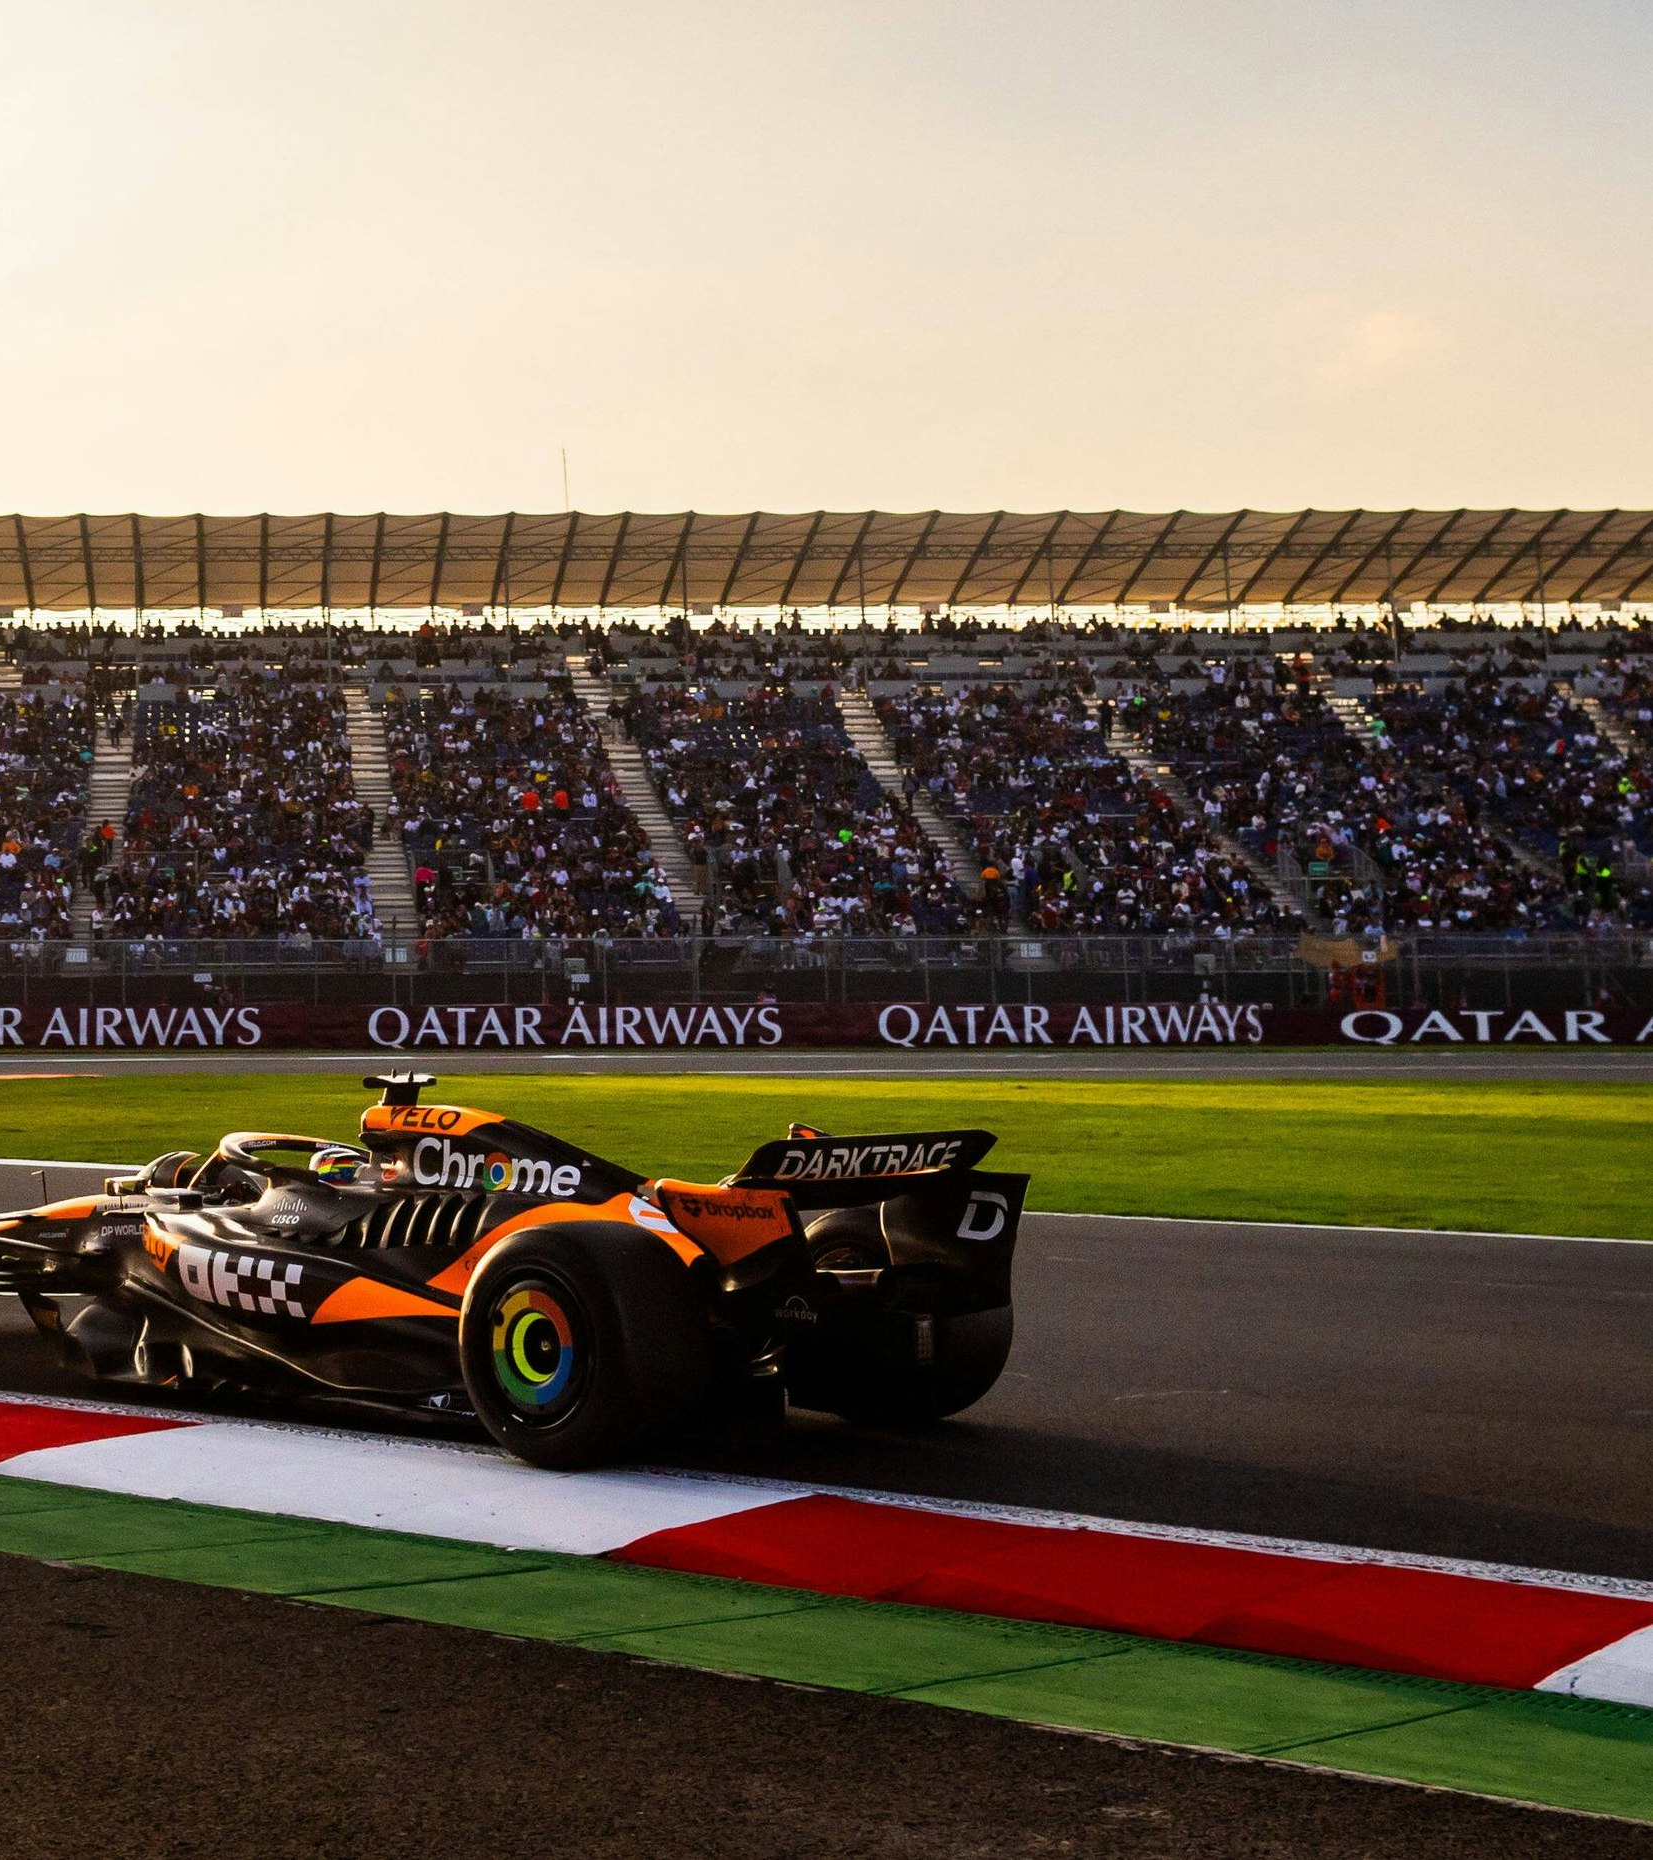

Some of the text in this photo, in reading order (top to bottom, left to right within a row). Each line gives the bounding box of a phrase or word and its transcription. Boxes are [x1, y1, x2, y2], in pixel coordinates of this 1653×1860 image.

[40, 1007, 261, 1046] AIRWAYS
[368, 1006, 782, 1049] QATAR AIRWAYS
[878, 1004, 1263, 1047] QATAR AIRWAYS
[1340, 1010, 1612, 1045] QATAR
[390, 1106, 462, 1130] VELO
[413, 1137, 582, 1197] Chrome
[774, 1141, 963, 1180] DARKTRACE
[101, 1224, 145, 1238] DP WORLD
[271, 1214, 300, 1225] CISCO
[956, 1190, 1008, 1241] D
